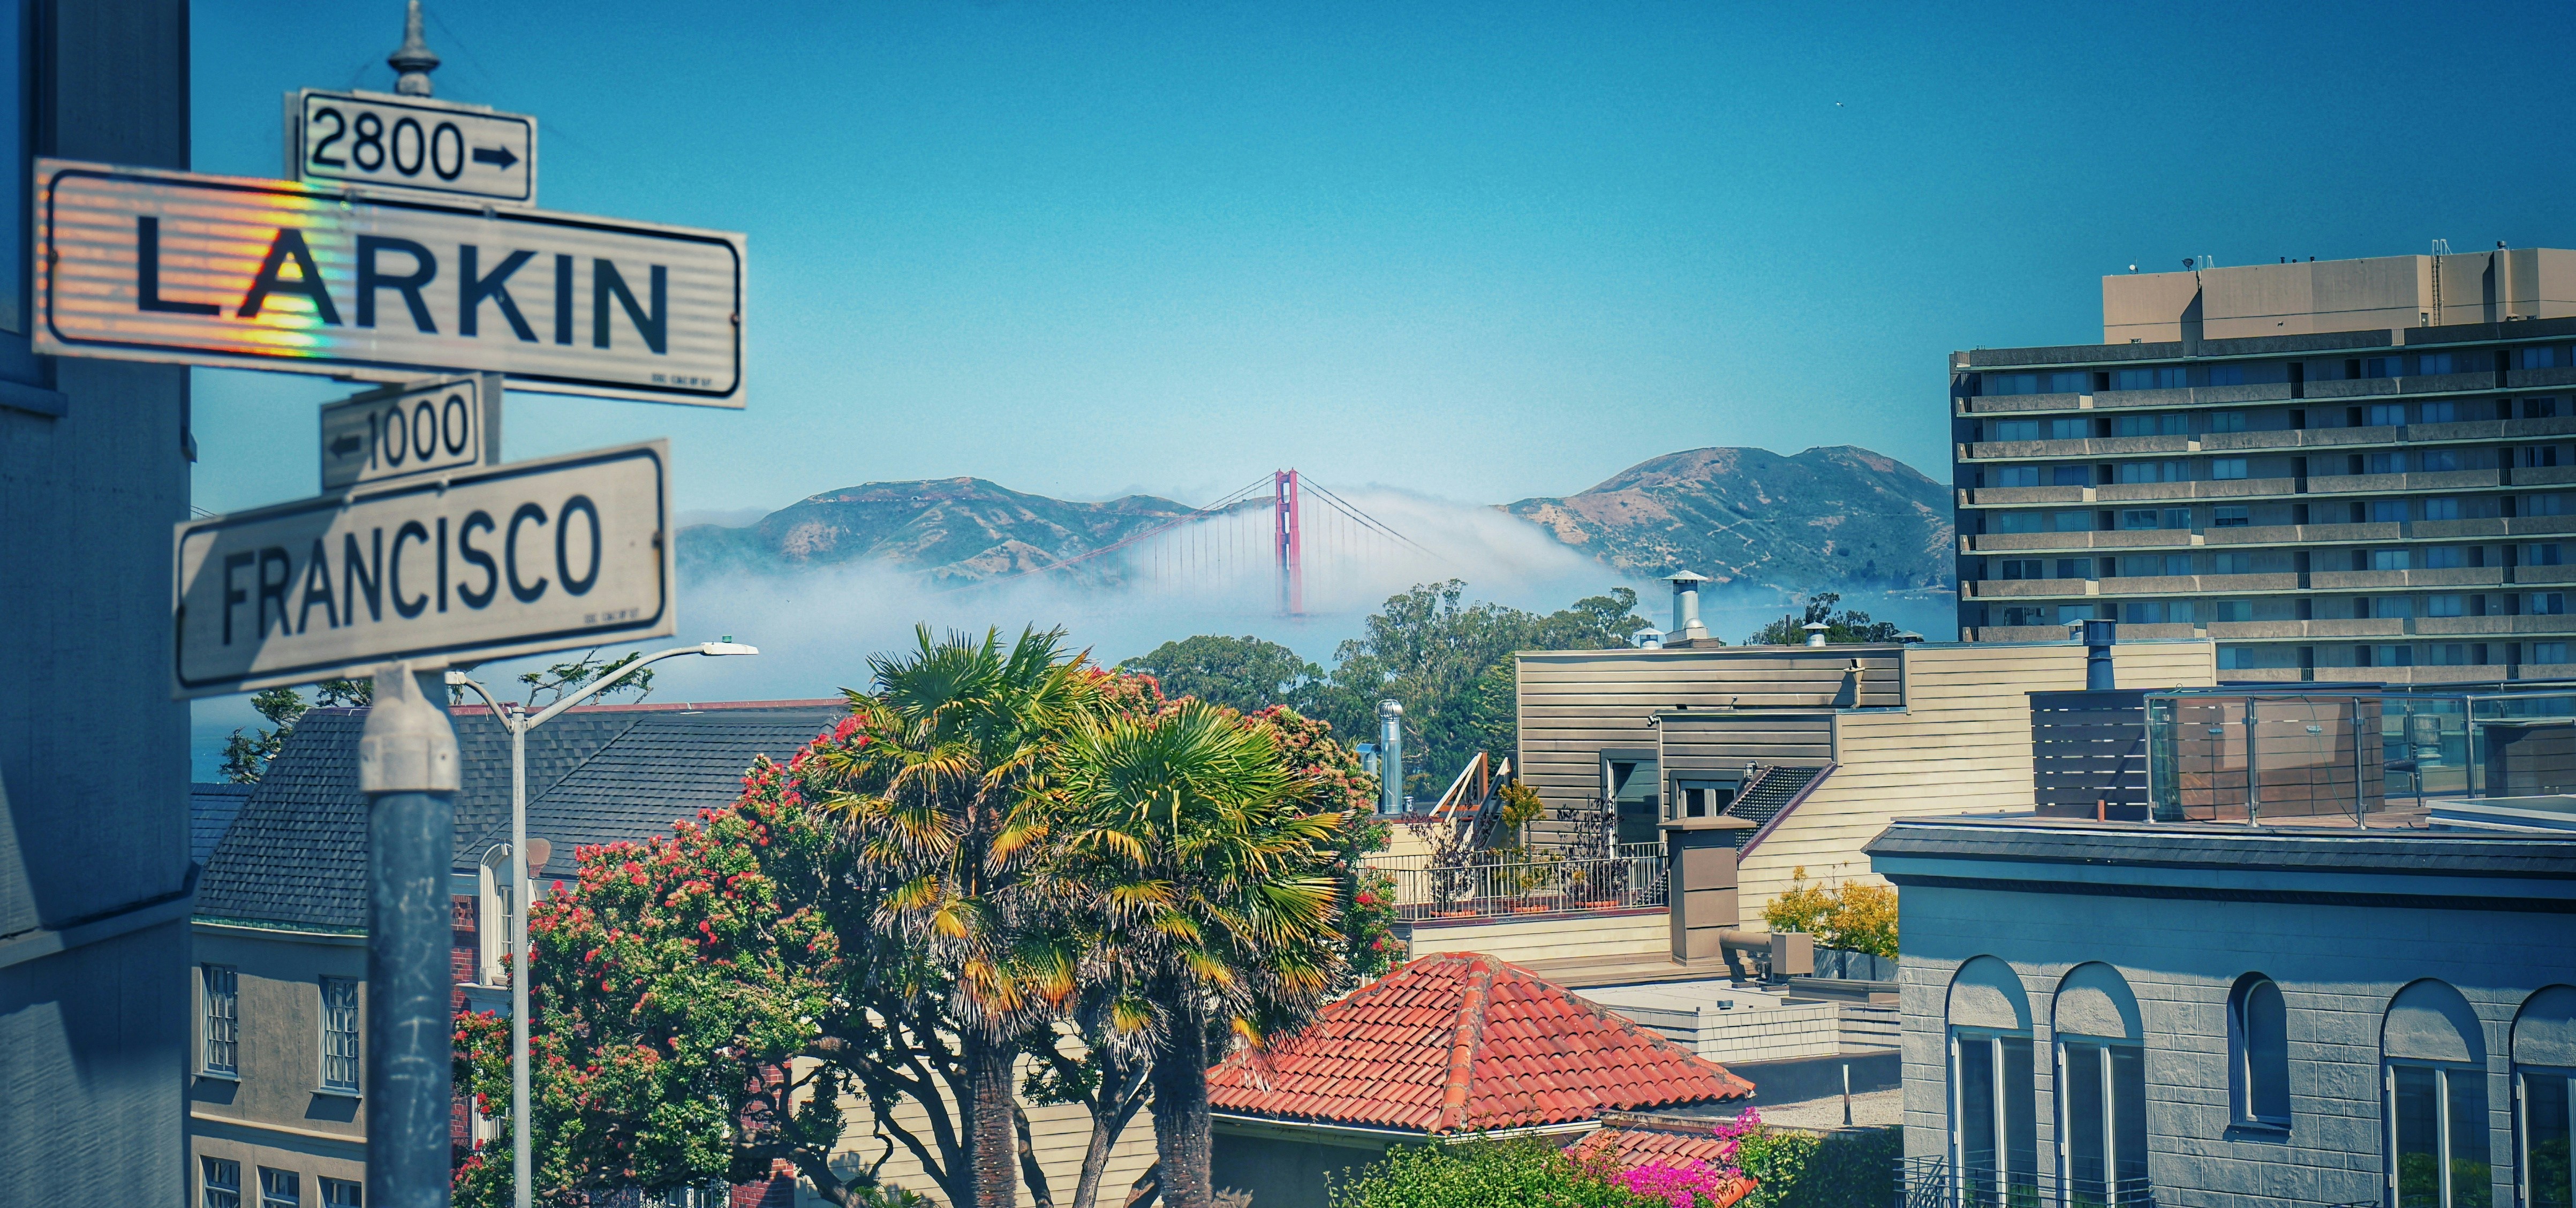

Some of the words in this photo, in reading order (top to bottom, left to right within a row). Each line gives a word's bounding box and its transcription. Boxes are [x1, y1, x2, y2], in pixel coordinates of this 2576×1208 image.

[311, 107, 464, 181] 2800
[137, 215, 668, 355] LARKIN
[366, 395, 467, 470] 1000
[222, 495, 601, 646] FRANCISCO
